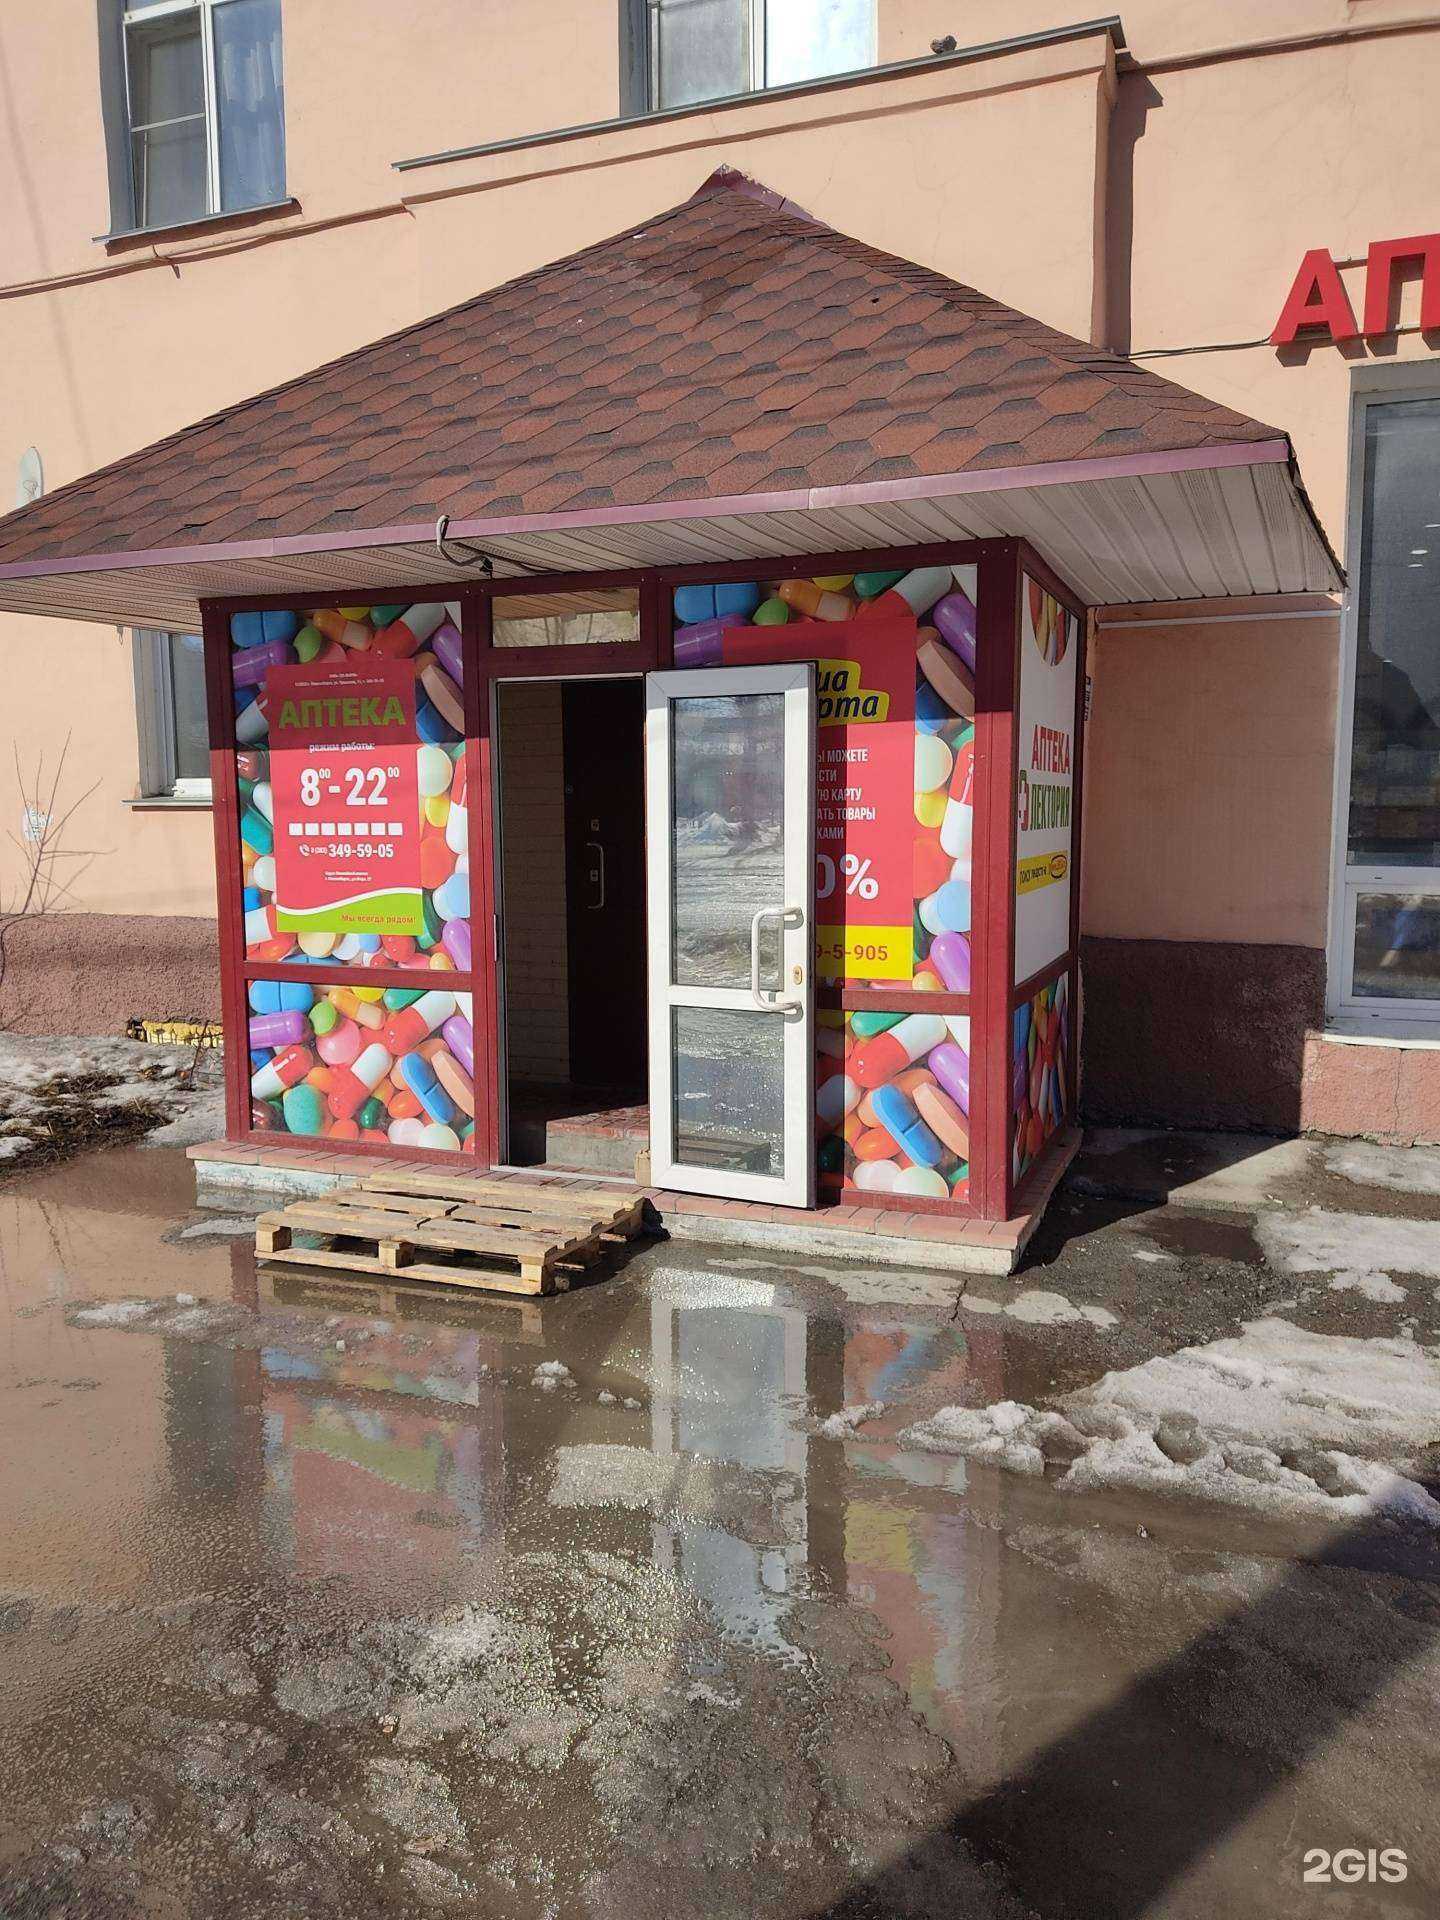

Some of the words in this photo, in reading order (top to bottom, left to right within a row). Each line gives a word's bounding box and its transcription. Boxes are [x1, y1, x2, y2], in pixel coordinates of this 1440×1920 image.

[1270, 233, 1440, 346] АП
[279, 696, 406, 729] АПТЕКА
[816, 696, 879, 718] рта
[827, 748, 868, 763] МОЖЕТЕ
[1032, 724, 1071, 775] АПТЕКА
[817, 769, 837, 782] СТИ
[832, 787, 862, 801] КАРТУ
[817, 807, 835, 821] АТЬ
[836, 807, 876, 821] ТОВАРЫ
[816, 827, 844, 840] КАМИ
[328, 843, 394, 858] 349-59-05
[816, 853, 879, 900] 0%
